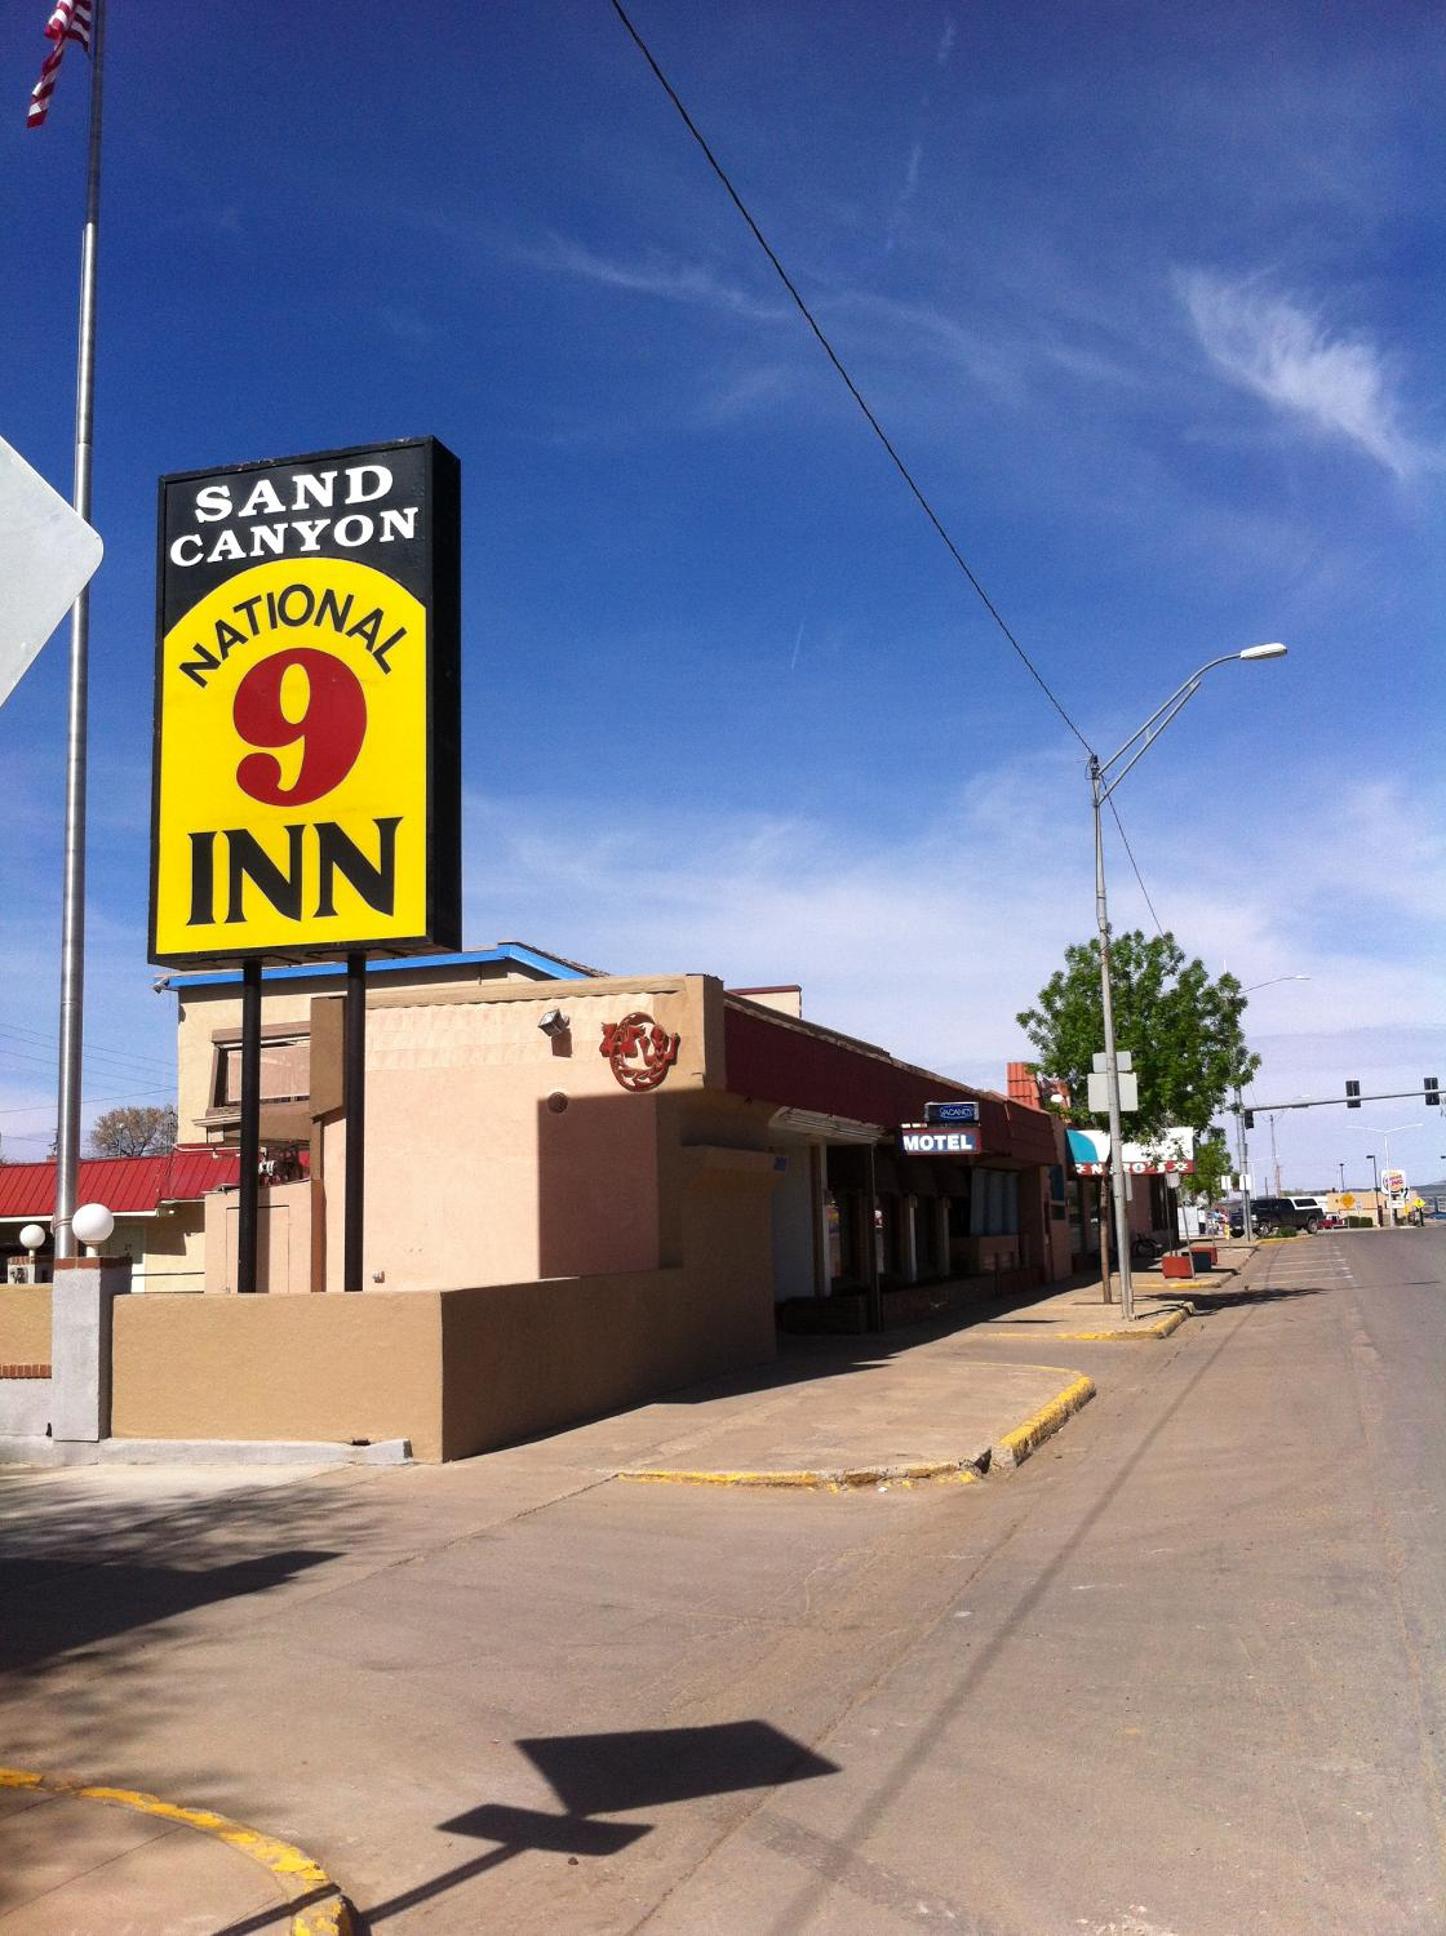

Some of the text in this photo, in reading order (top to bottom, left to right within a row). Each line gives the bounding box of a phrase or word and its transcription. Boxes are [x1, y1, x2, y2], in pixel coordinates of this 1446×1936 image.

[195, 464, 393, 525] SAND
[169, 506, 419, 568] CANYON
[179, 583, 408, 688] NATIONAL
[233, 647, 367, 807] 9
[186, 816, 404, 926] INN
[902, 1134, 973, 1151] MOTEL
